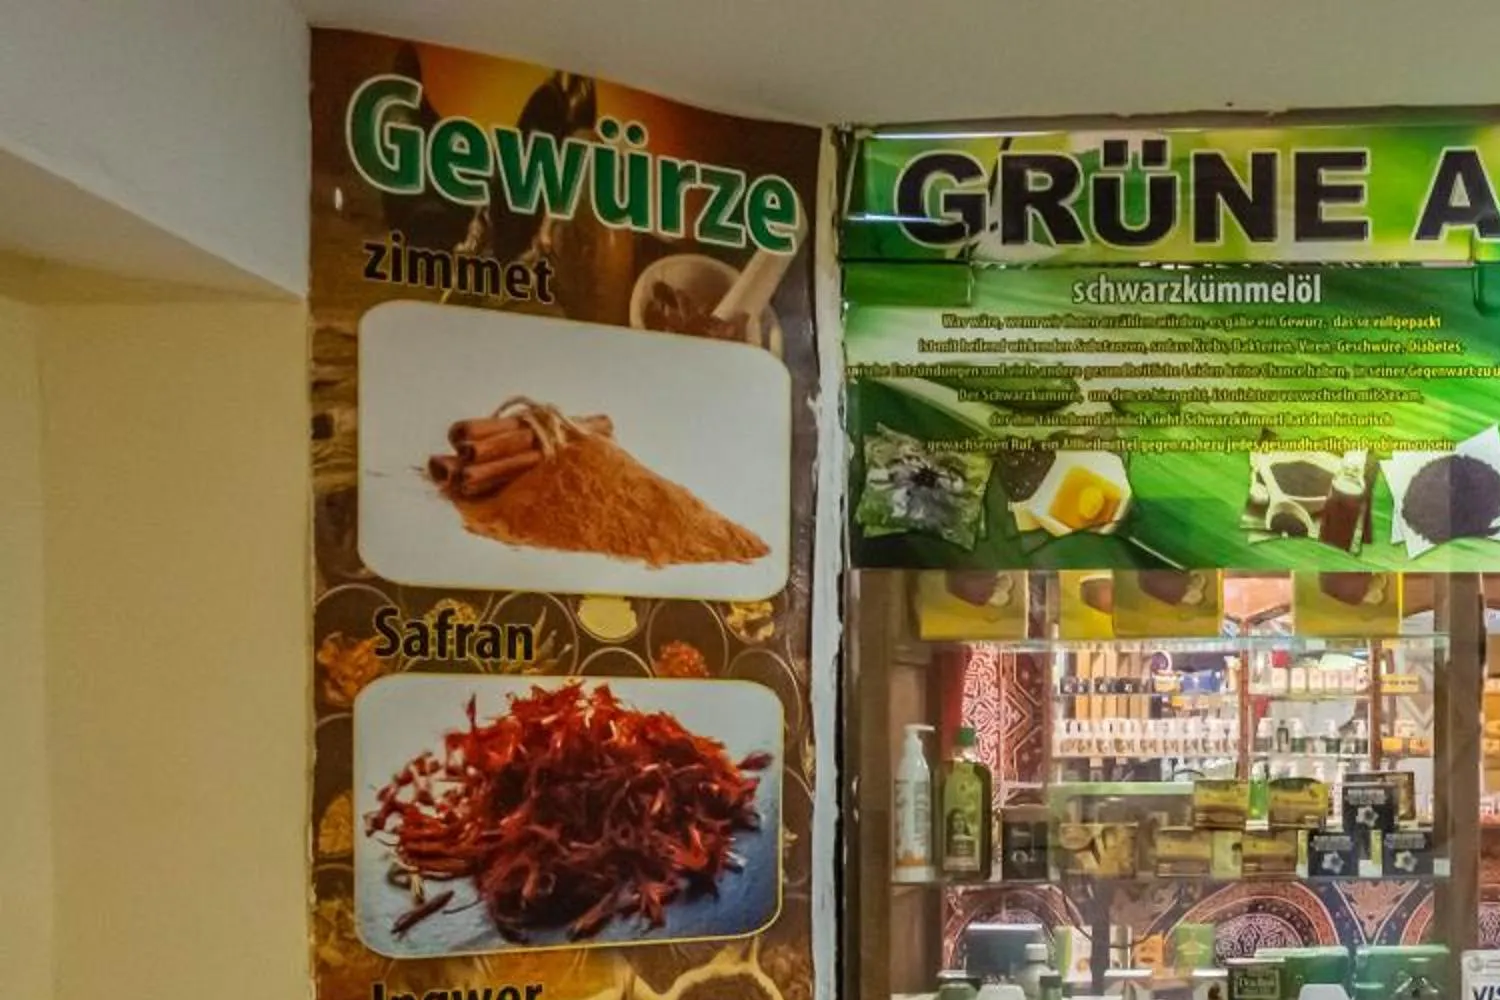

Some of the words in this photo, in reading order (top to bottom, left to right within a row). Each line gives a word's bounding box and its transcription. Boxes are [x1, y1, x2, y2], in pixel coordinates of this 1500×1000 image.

[346, 72, 800, 255] Gewürze
[896, 138, 1371, 248] GRÜNE
[362, 230, 555, 302] zimmet
[1073, 273, 1321, 303] schwarzkümmelöl
[374, 606, 535, 661] Safran
